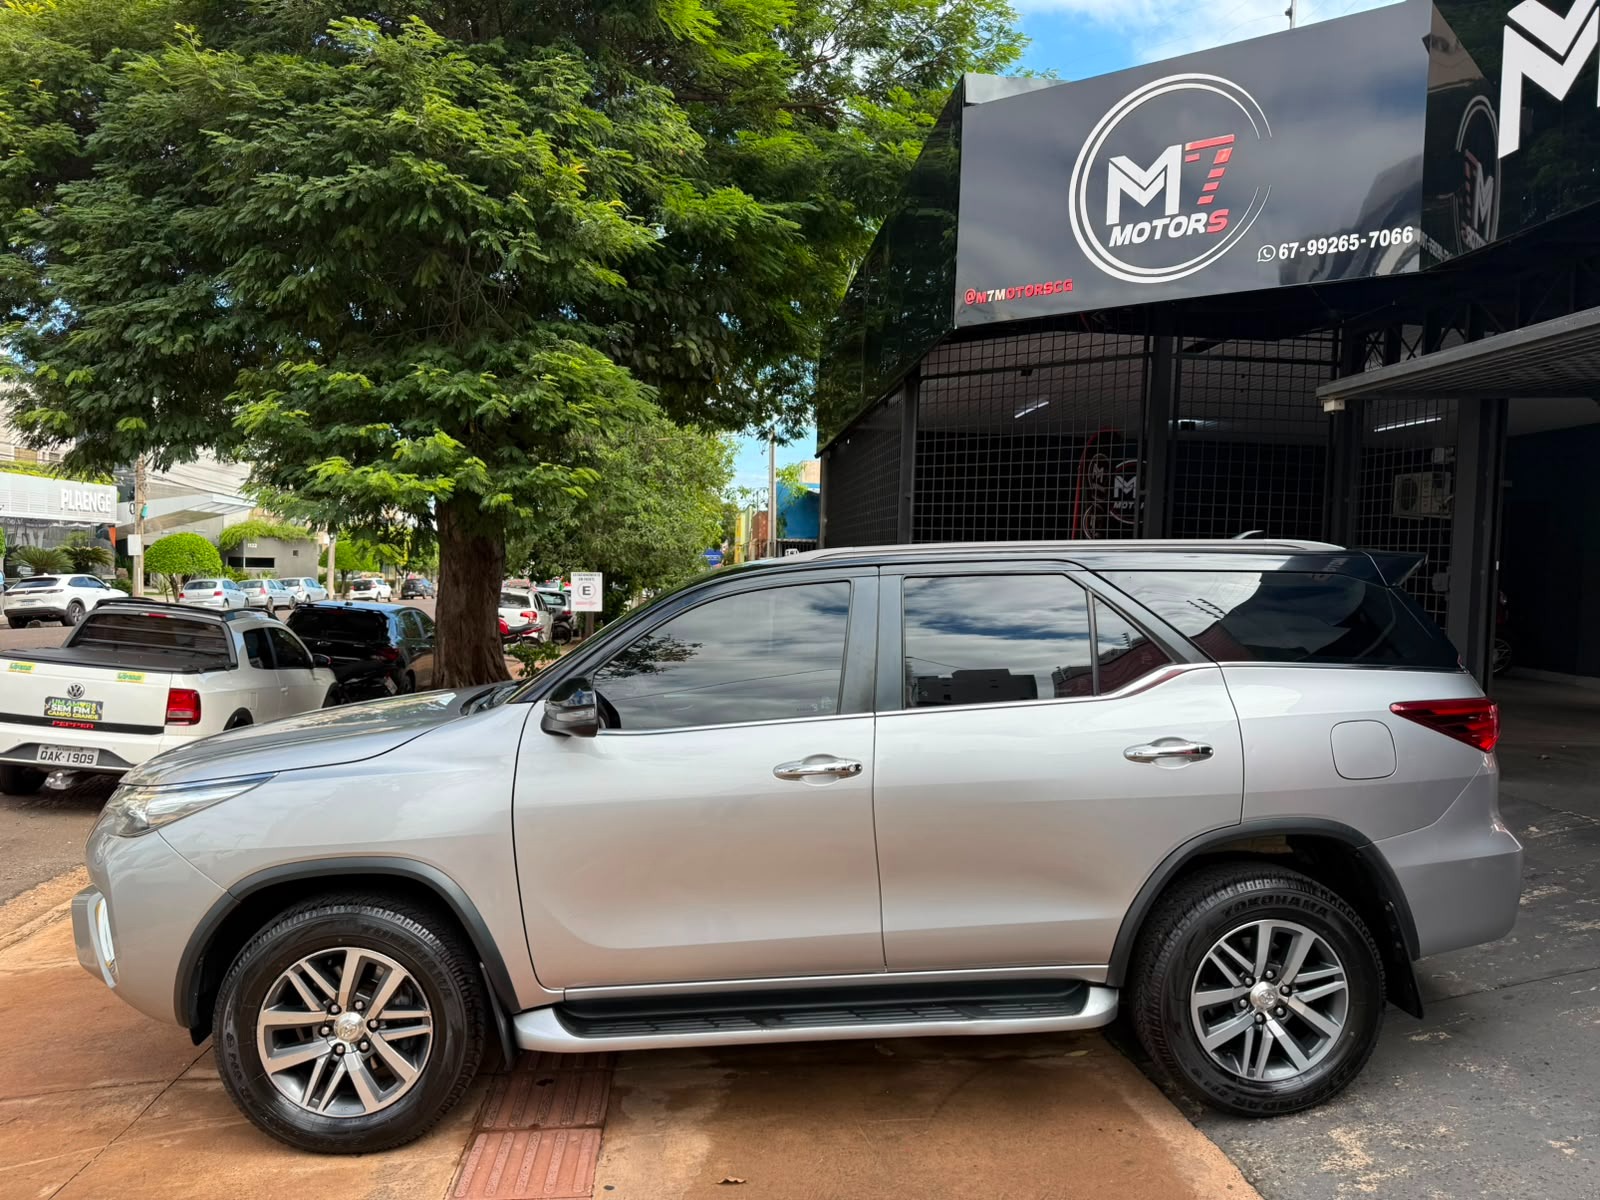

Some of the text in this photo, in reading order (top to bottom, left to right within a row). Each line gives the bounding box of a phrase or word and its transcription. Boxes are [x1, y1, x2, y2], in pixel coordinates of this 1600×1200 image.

[1106, 133, 1235, 225] M7
[1108, 207, 1230, 247] MOTORS
[1278, 226, 1414, 261] 67-99265-7066
[964, 278, 1074, 306] @M7MOTORSCG
[61, 488, 112, 513] PLAENGE
[582, 585, 592, 596] E
[51, 704, 71, 713] SEM
[73, 706, 90, 714] FIM
[52, 720, 94, 729] PEPPER
